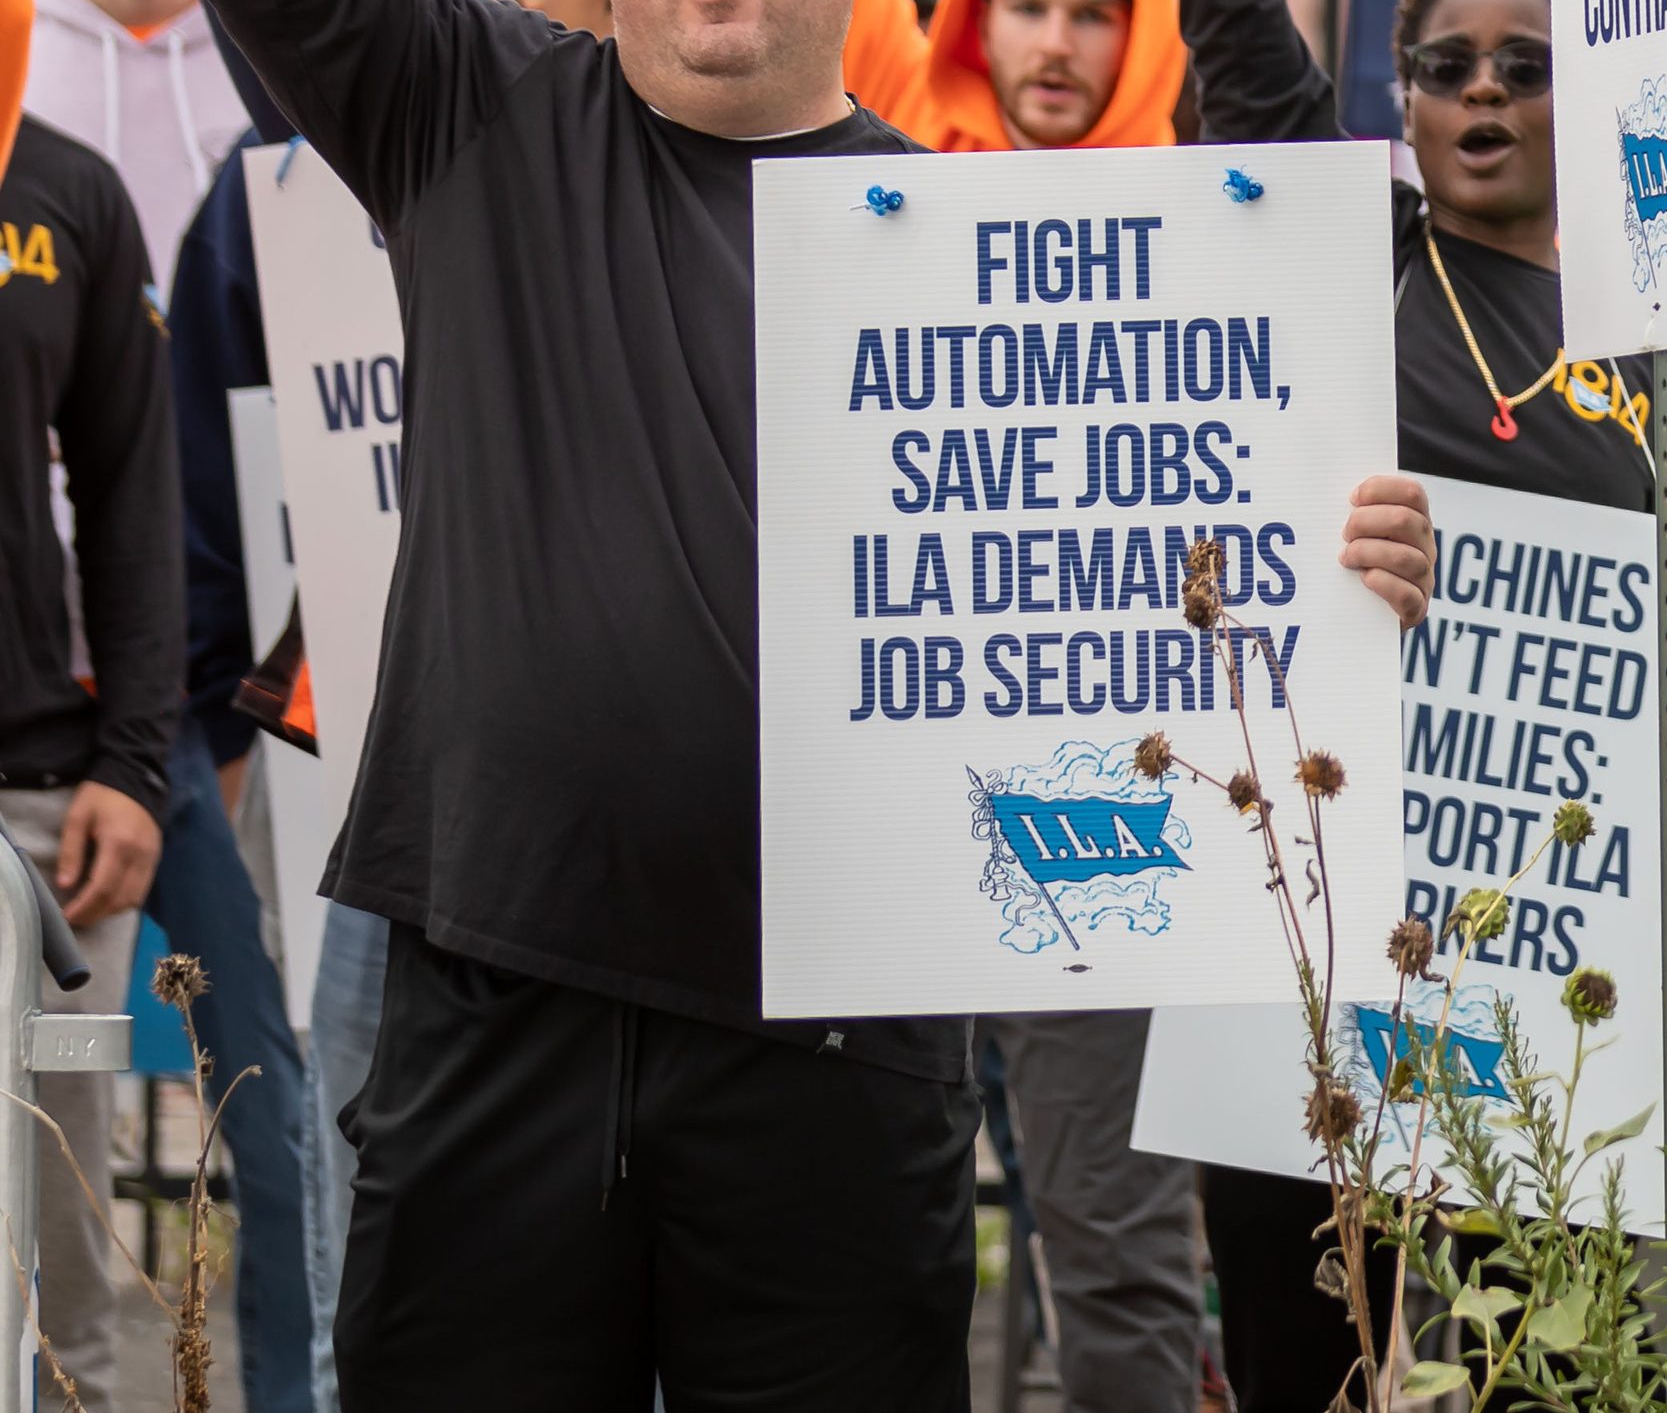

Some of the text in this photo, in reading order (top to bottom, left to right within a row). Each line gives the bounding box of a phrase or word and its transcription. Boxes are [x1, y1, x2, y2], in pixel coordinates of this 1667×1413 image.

[977, 216, 1161, 305] FIGHT
[848, 317, 1291, 411] AUTOMATION,
[891, 419, 1252, 514] SAVE JOBS:
[853, 522, 1296, 619] ILA DEMANDS
[849, 625, 1300, 722] JOB SECURITY
[1506, 631, 1648, 720] FEED
[1018, 814, 1162, 863] I.L.A.
[1546, 824, 1630, 898] ILA
